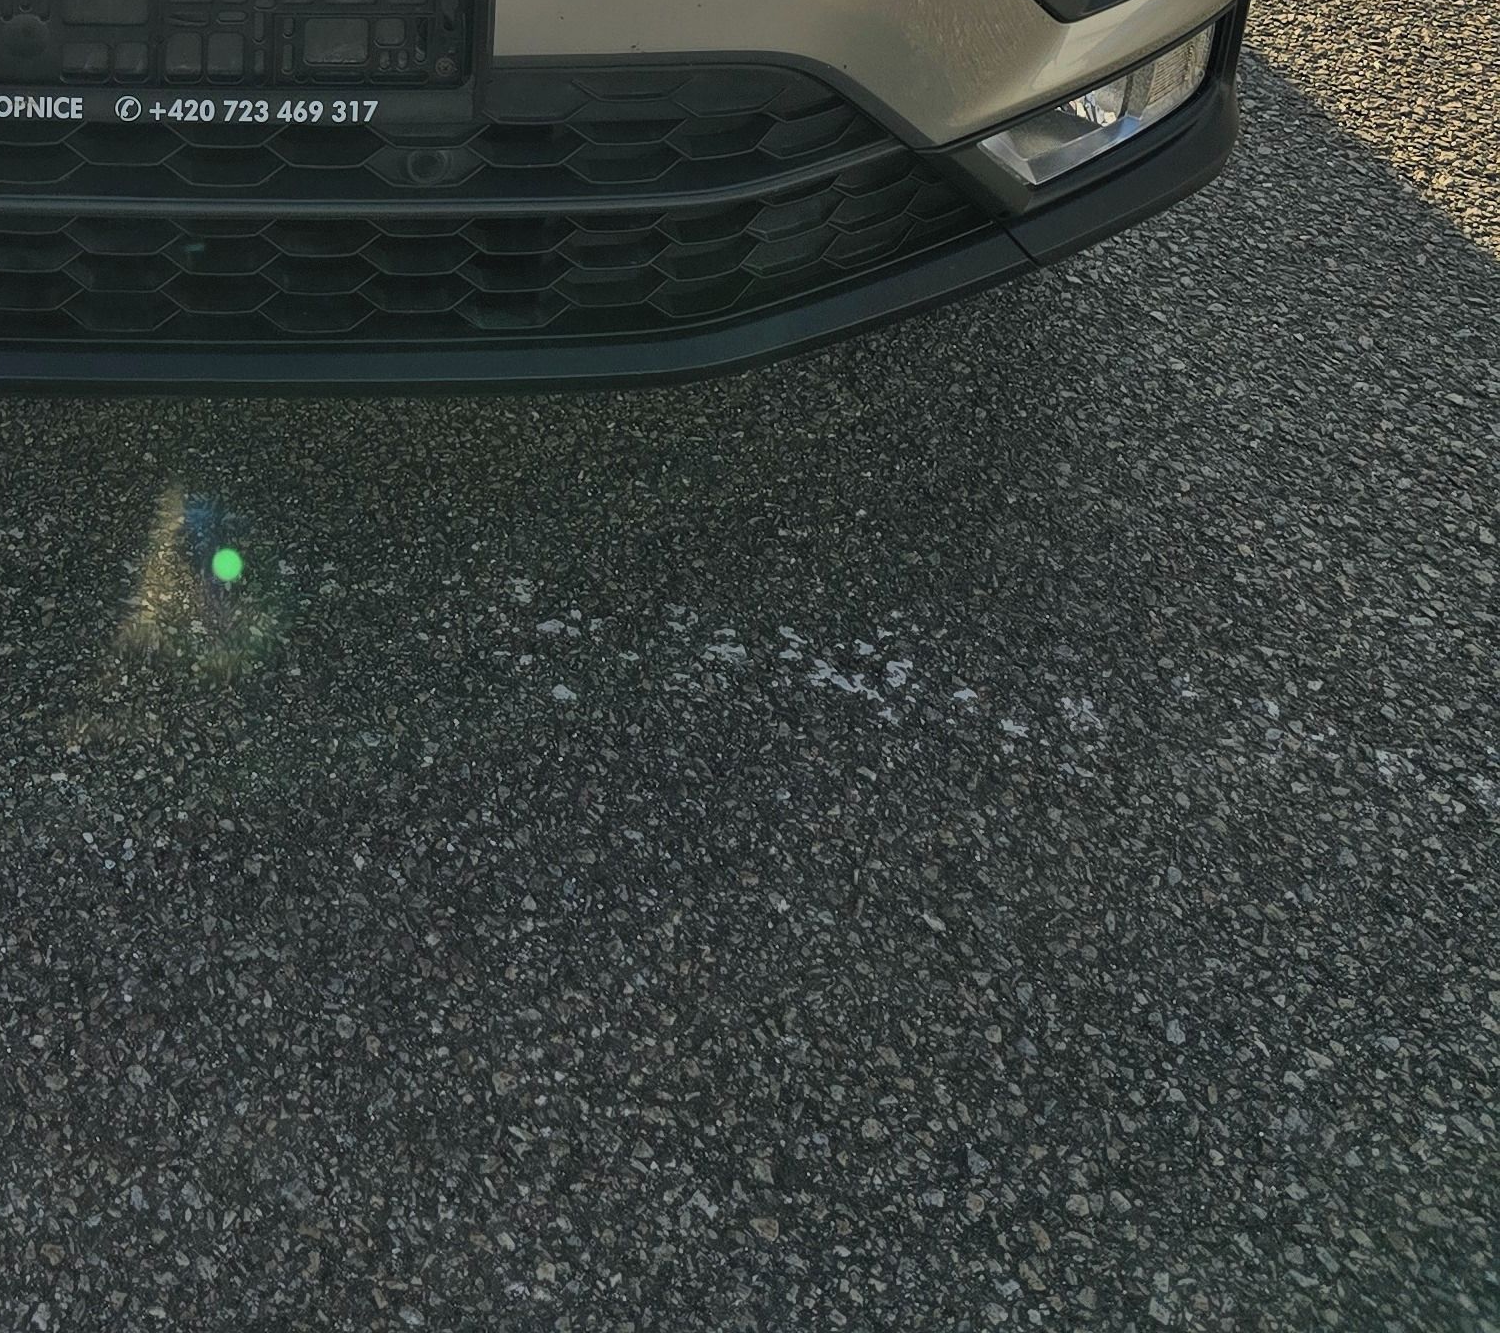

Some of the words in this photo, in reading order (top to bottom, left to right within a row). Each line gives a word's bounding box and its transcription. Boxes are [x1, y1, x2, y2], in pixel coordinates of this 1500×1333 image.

[148, 98, 216, 122] +420
[223, 99, 269, 123] 723
[276, 100, 324, 123] 469
[331, 100, 379, 123] 317
